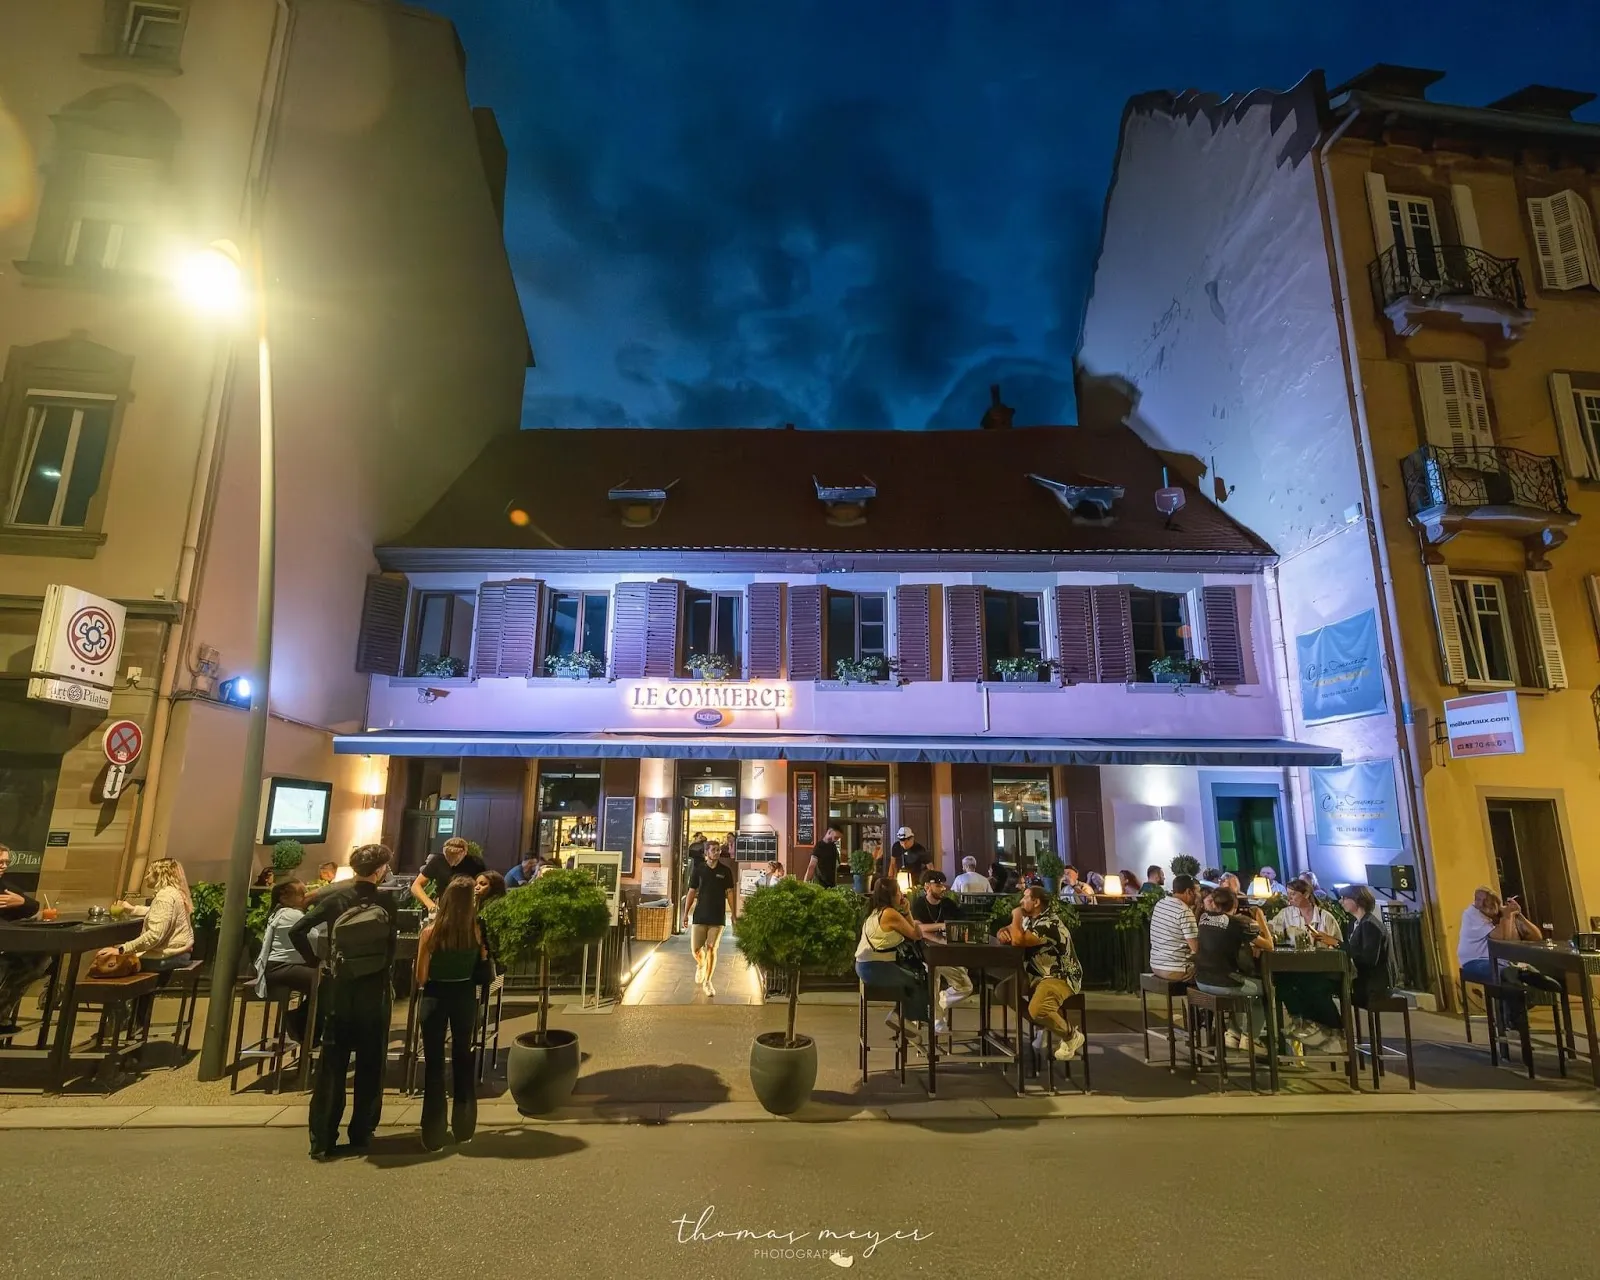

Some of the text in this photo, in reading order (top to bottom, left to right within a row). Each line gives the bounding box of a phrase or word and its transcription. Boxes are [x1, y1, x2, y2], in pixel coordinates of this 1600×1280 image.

[83, 688, 109, 705] Pilates
[634, 687, 786, 708] LE COMMERCE
[1400, 878, 1408, 888] 3
